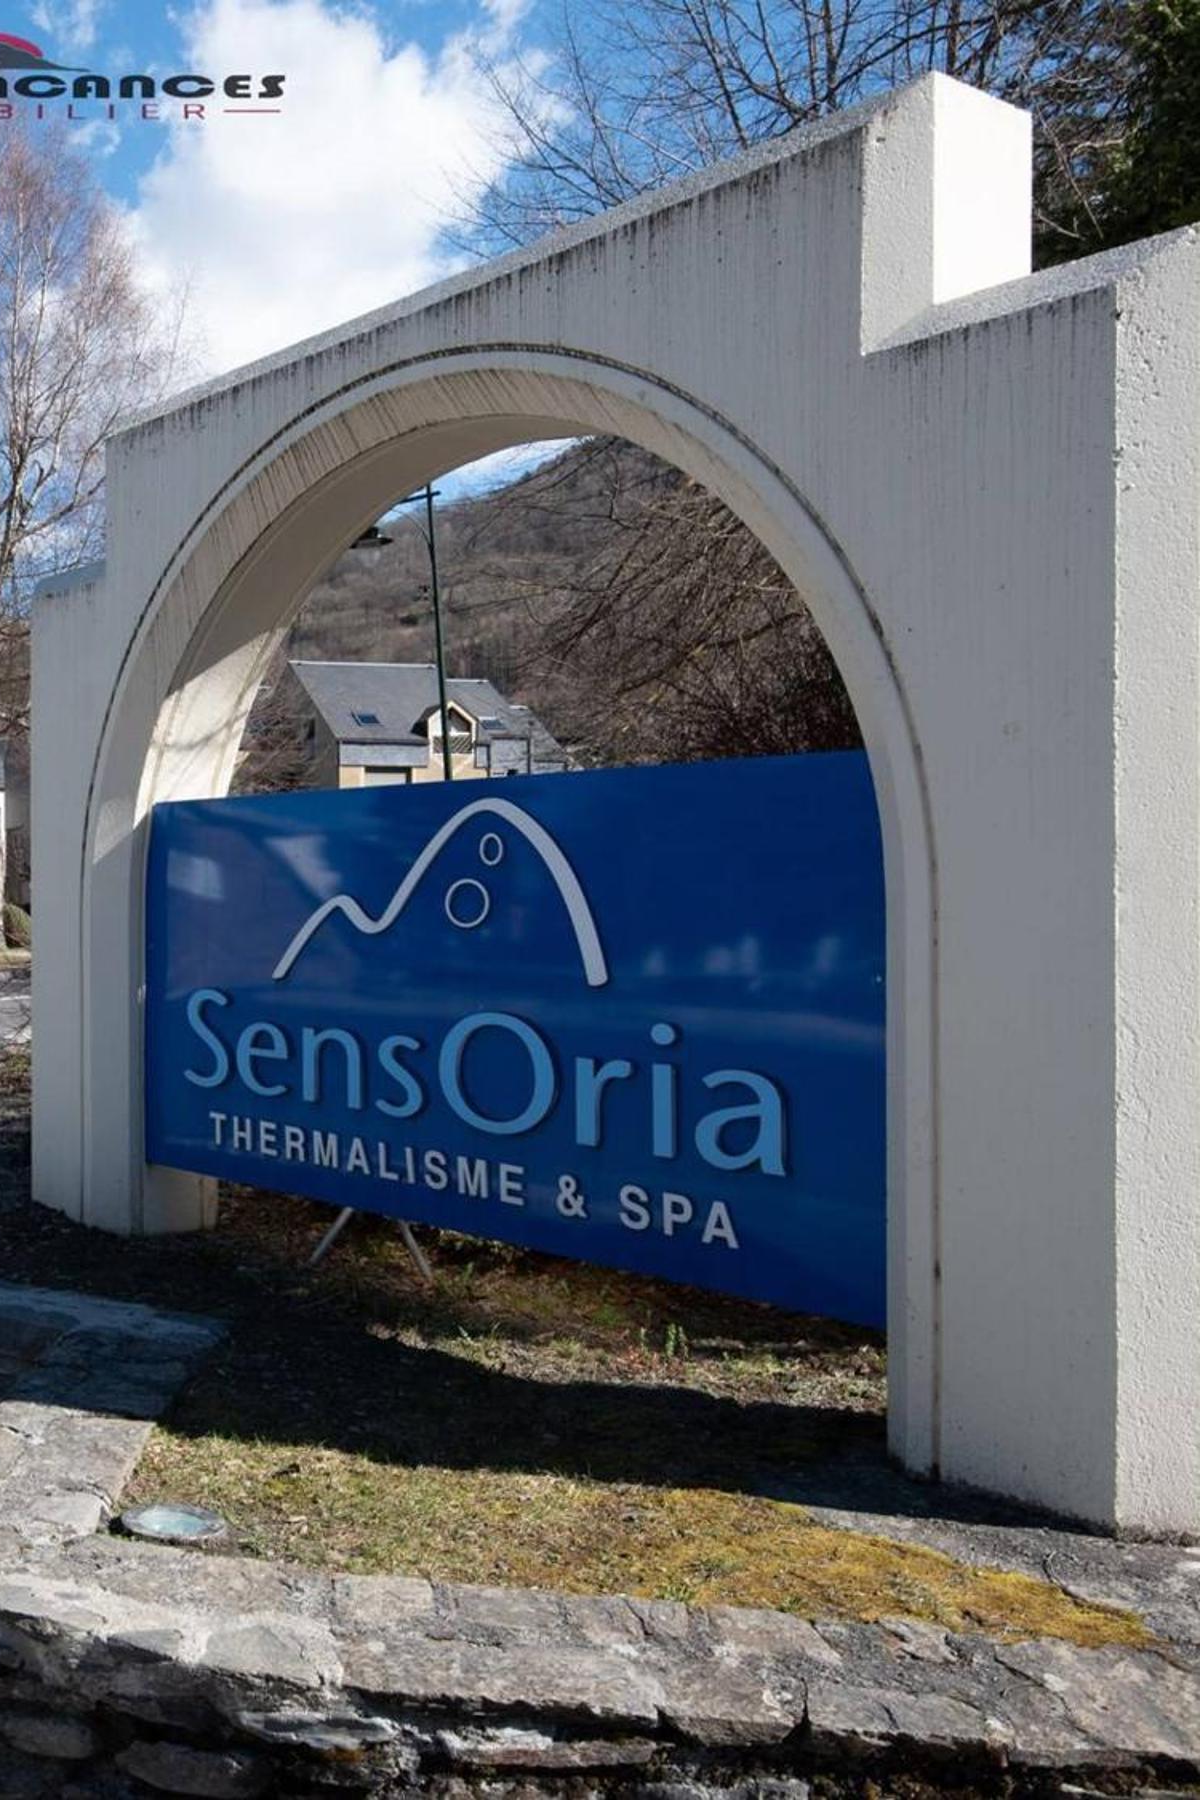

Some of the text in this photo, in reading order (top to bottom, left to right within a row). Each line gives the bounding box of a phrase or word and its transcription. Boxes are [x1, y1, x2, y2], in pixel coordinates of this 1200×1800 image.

[183, 988, 788, 1178] SensOria
[208, 1111, 740, 1250] THERMALISME & SPA
